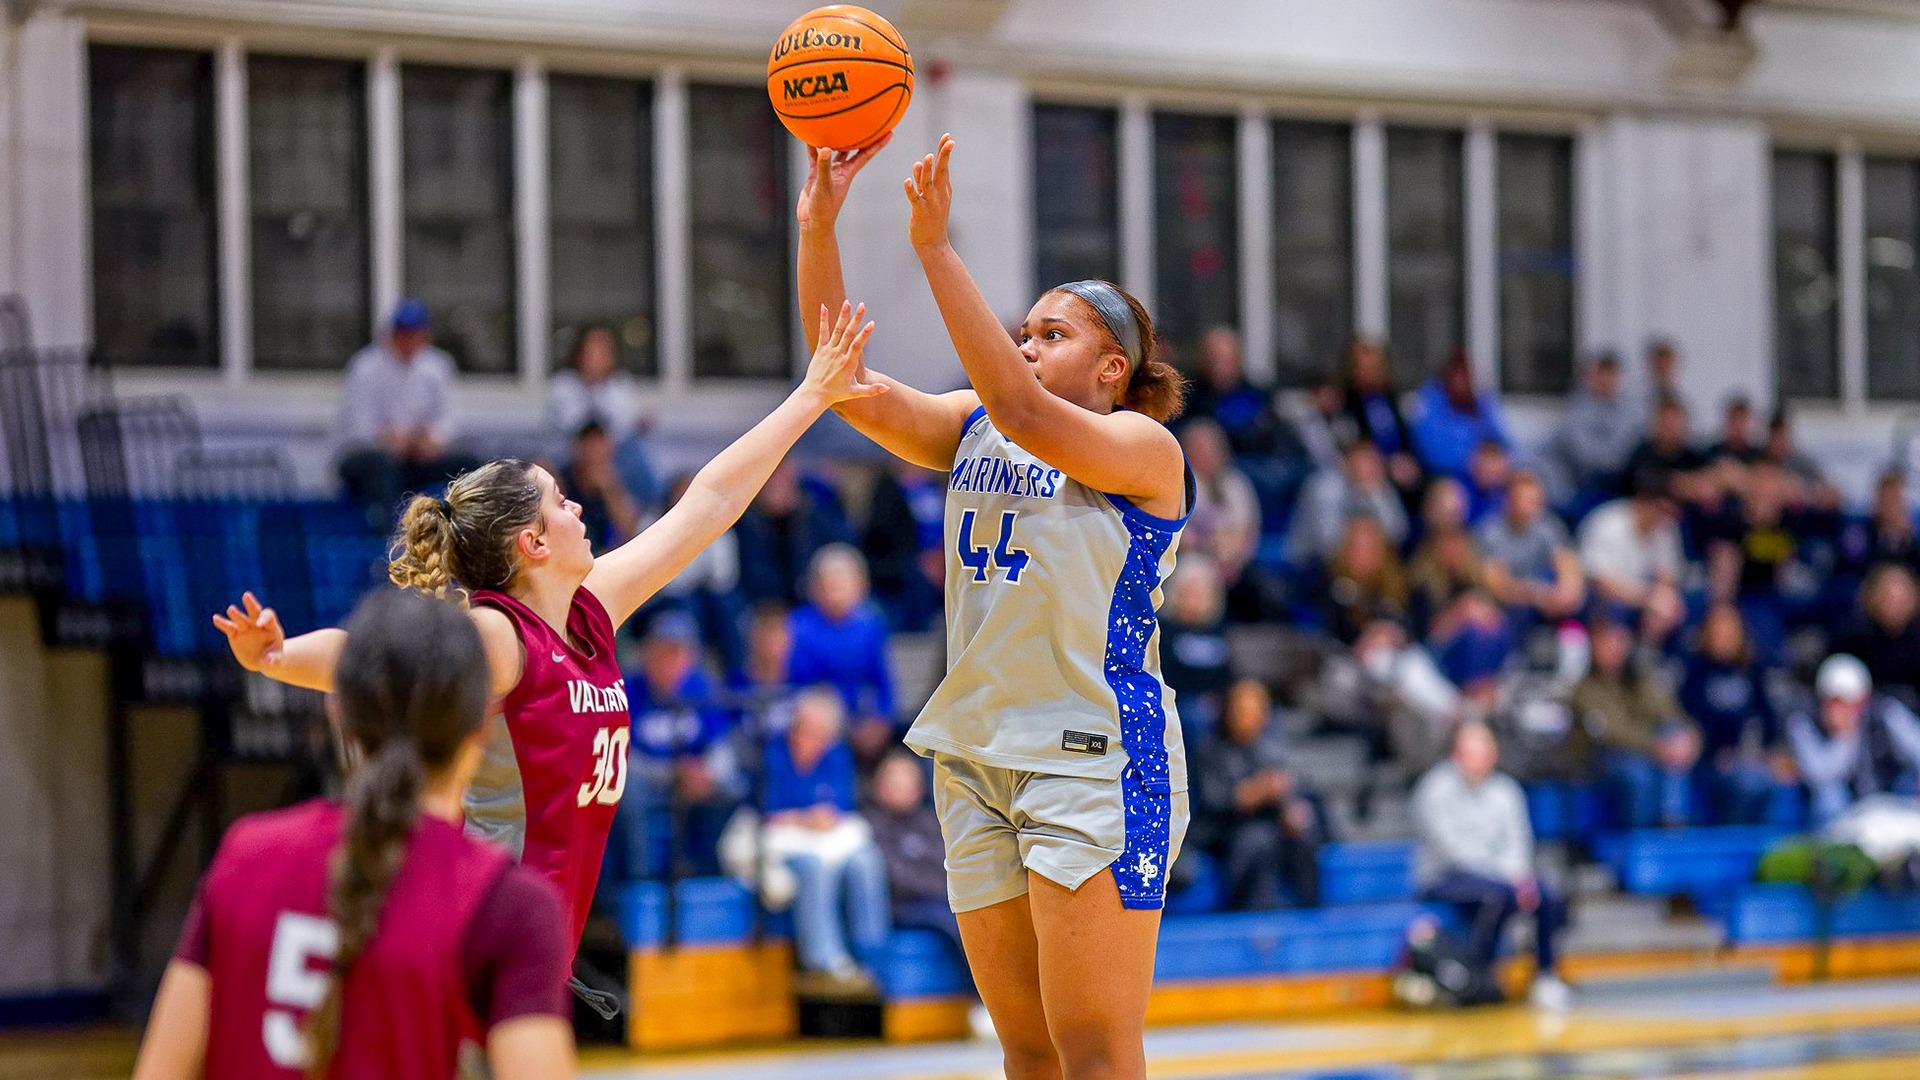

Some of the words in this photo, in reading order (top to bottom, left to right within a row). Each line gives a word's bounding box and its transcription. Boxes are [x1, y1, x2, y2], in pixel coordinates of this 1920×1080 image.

[774, 27, 862, 62] Wilson
[783, 71, 849, 101] NCAA
[949, 456, 1061, 499] MARINERS
[956, 508, 1031, 586] 44
[1090, 740, 1103, 749] XXL
[577, 725, 630, 808] 30
[261, 909, 341, 1070] 5
